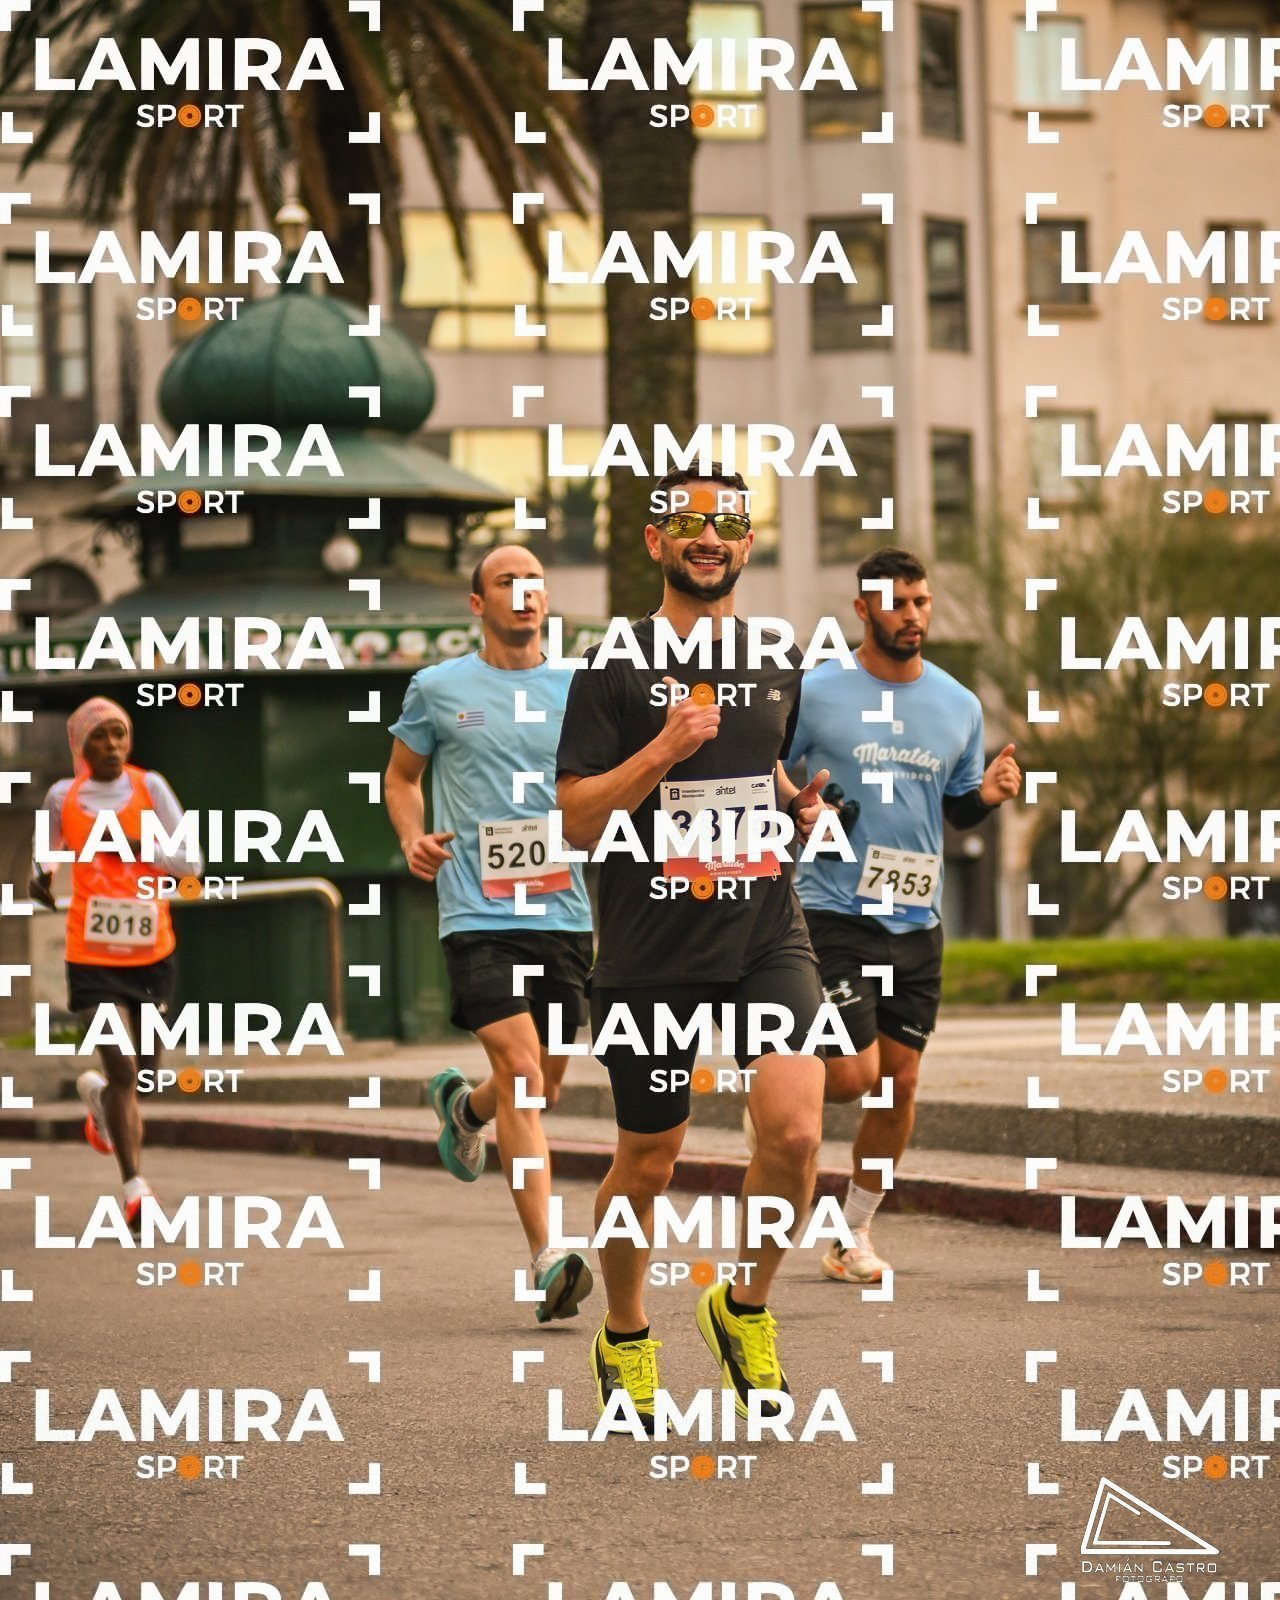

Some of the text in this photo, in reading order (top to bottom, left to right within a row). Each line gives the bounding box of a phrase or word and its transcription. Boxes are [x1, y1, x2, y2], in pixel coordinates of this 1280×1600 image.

[853, 742, 941, 772] Maratón
[487, 840, 556, 870] 520
[867, 866, 932, 897] 7853
[90, 912, 152, 937] 2018
